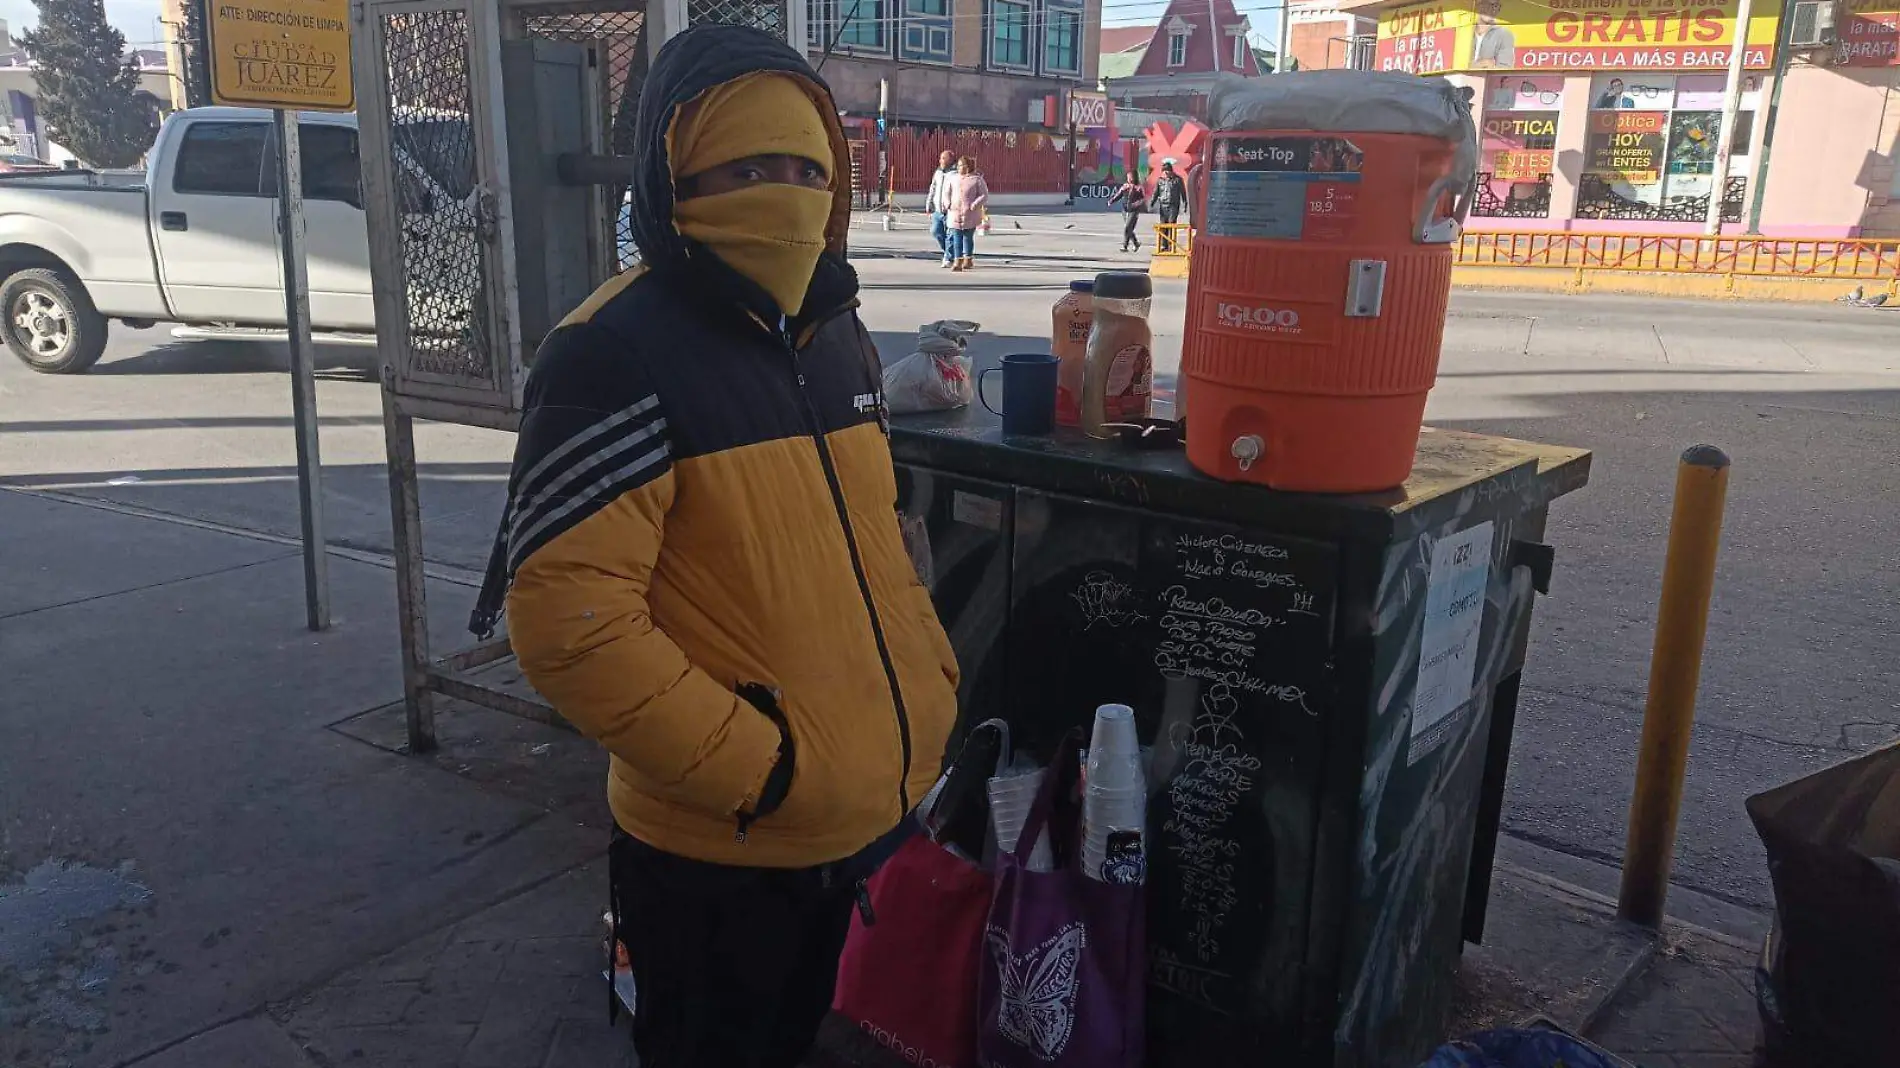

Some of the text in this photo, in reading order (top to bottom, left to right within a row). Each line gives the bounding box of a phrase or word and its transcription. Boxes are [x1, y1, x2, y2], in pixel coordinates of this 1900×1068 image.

[246, 8, 301, 27] DIRECCIÓN
[303, 15, 315, 28] DE
[316, 18, 344, 32] LIMPIA
[1389, 6, 1445, 35] ÓPTICA
[1546, 9, 1726, 43] GRATIS
[1849, 19, 1897, 34] la más
[1394, 32, 1435, 53] la más
[233, 43, 337, 65] CIUDAD
[1382, 50, 1445, 73] BARATA
[1522, 49, 1596, 67] ÓPTICA
[1601, 50, 1627, 66] LA
[1632, 48, 1676, 66] MÁS
[235, 59, 337, 89] JUÁREZ
[1607, 133, 1644, 147] HOY
[1237, 146, 1295, 165] Seat-Top
[1621, 149, 1652, 157] OFERTA
[1326, 188, 1336, 200] 5
[1217, 302, 1300, 329] IGLOO
